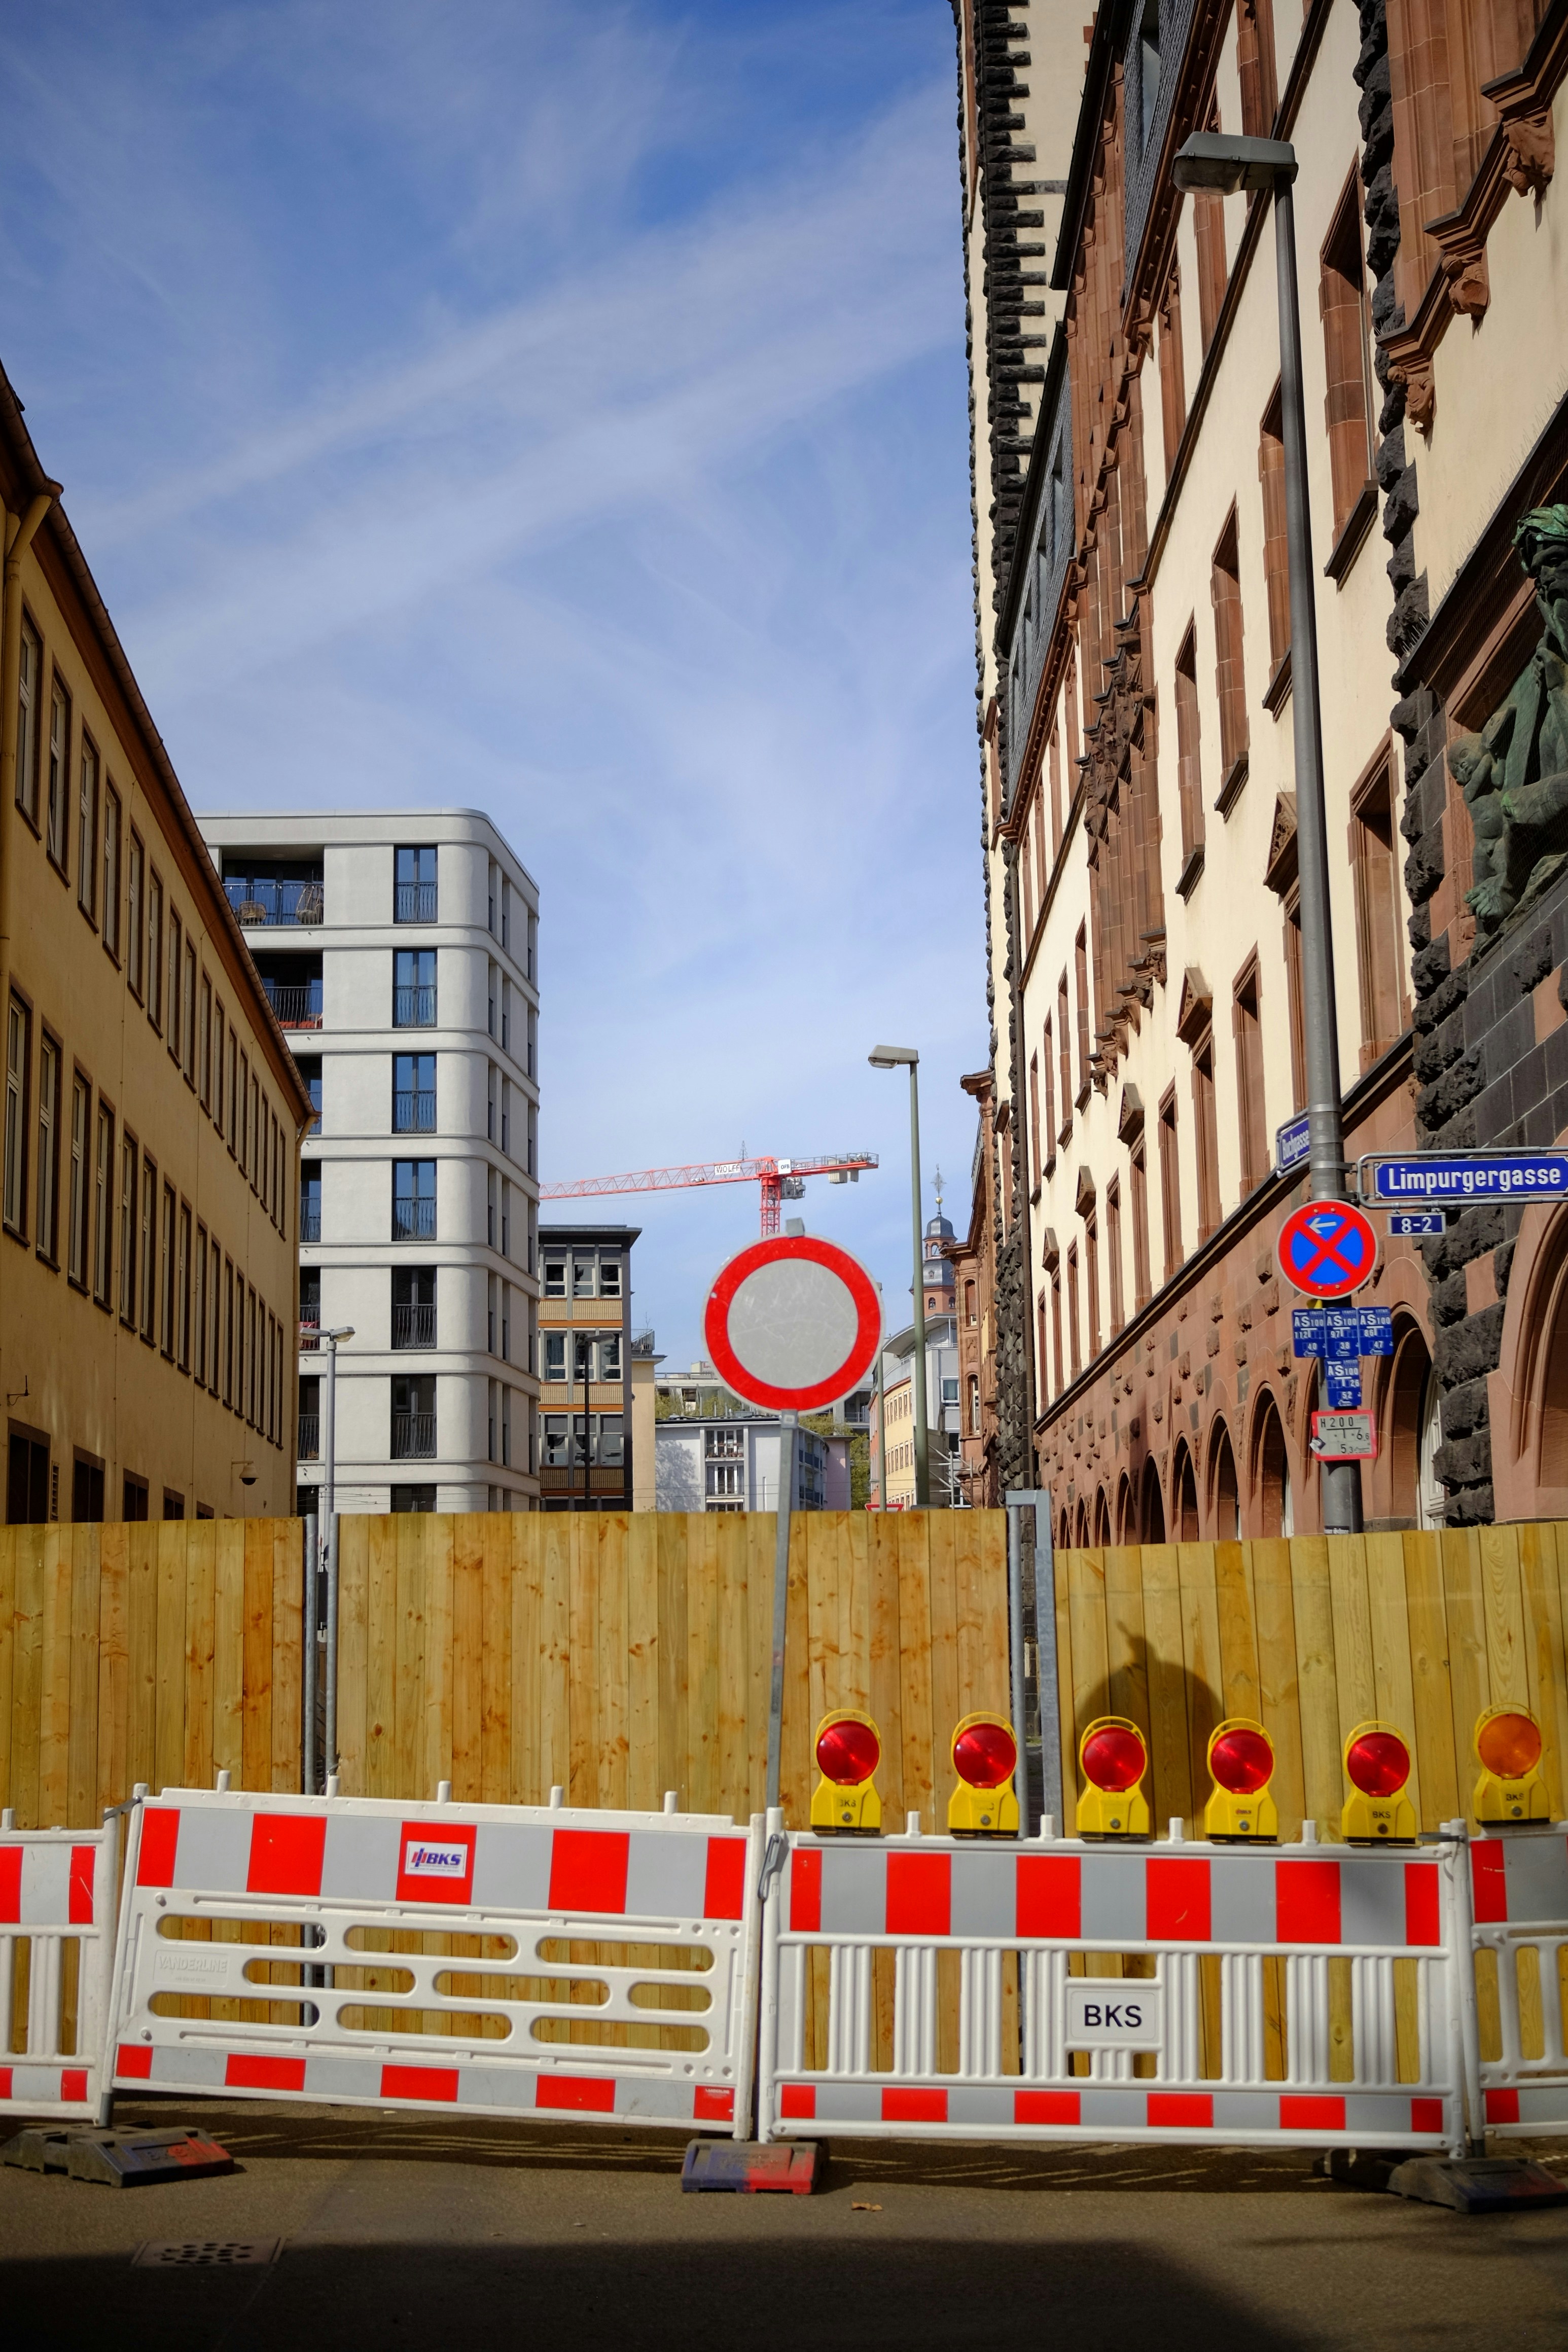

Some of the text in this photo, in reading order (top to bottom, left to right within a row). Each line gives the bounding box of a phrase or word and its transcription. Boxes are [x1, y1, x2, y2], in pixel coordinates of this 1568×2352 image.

[716, 1164, 740, 1173] WOLFF
[1388, 1168, 1561, 1192] Limpurgergasse
[1401, 1217, 1432, 1233] 8-2
[426, 1852, 461, 1866] BKS
[158, 1954, 228, 1973] VANDERLINE
[1084, 2005, 1142, 2027] BKS
